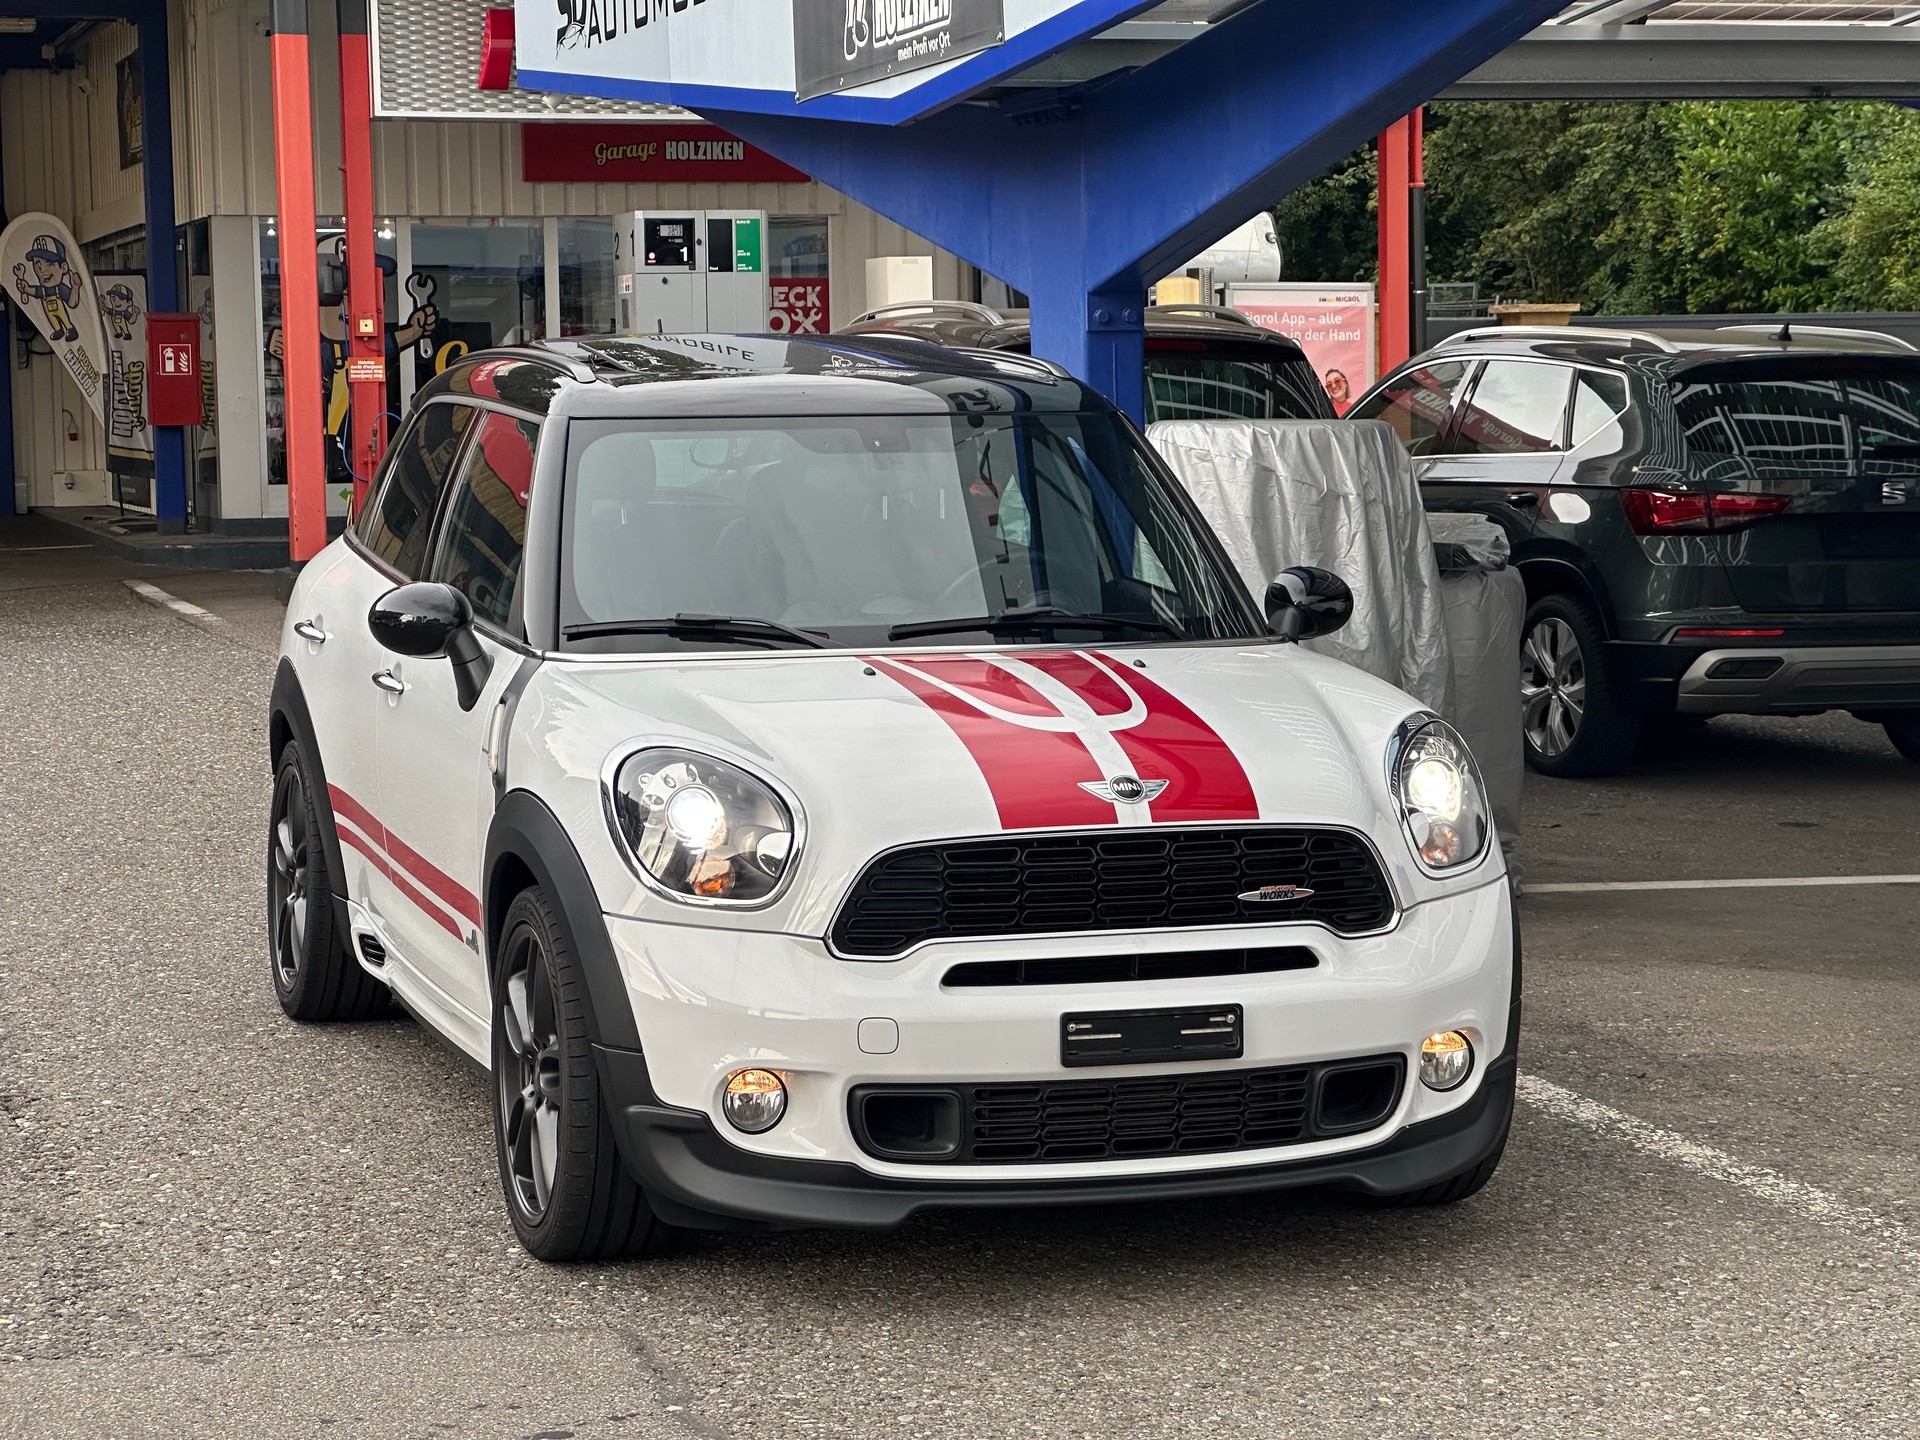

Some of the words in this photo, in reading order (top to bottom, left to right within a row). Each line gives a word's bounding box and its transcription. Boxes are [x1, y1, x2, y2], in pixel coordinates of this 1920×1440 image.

[588, 0, 706, 48] AUTO
[897, 42, 913, 61] mein
[913, 36, 928, 57] Profi
[928, 40, 939, 53] vor
[939, 31, 951, 48] Ort
[594, 142, 657, 166] Garage
[665, 141, 744, 160] HOLZIKEN
[680, 246, 688, 262] 1
[769, 286, 822, 308] ECK
[1245, 312, 1279, 326] igrol
[1281, 312, 1305, 326] App
[1318, 312, 1343, 325] alle
[1304, 328, 1328, 341] der
[1329, 329, 1361, 341] Hand
[1112, 782, 1141, 792] MINI
[1260, 890, 1295, 900] WORKS
